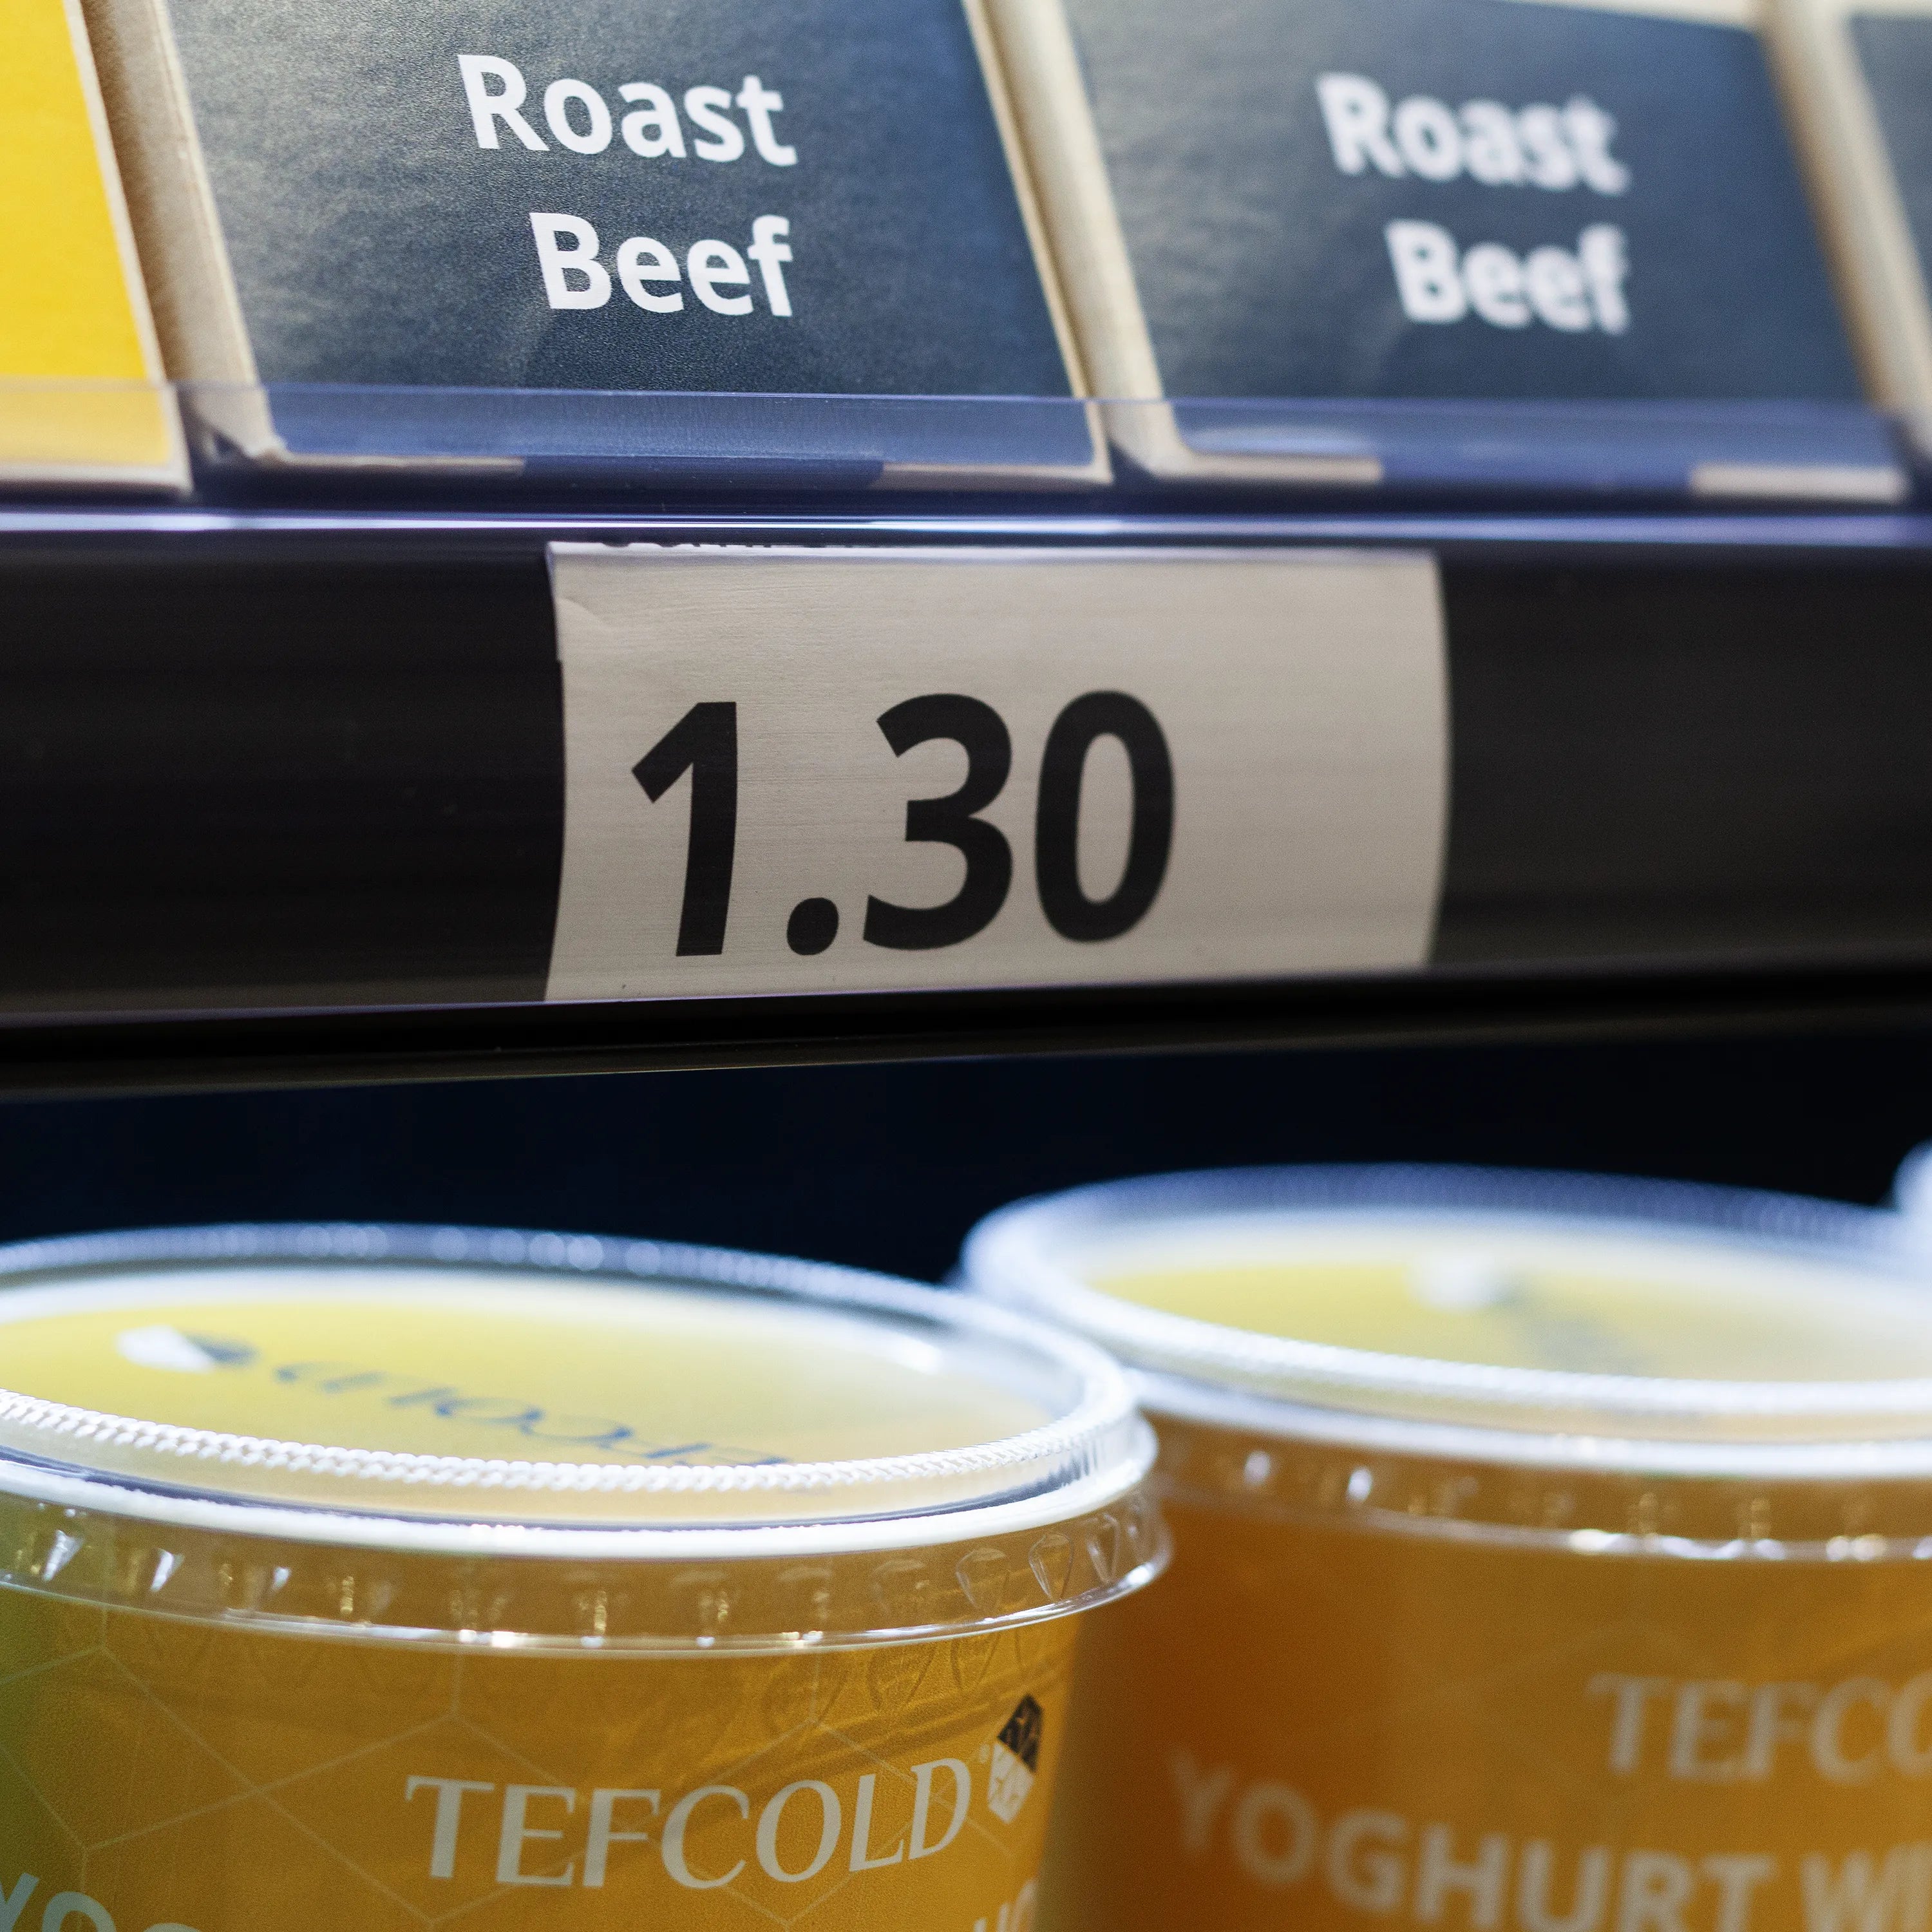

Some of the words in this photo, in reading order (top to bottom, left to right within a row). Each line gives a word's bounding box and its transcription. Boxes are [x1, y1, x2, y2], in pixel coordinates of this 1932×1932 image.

[458, 54, 797, 166] Roast
[1315, 72, 1632, 195] Roast
[529, 212, 793, 317] Beef
[1385, 219, 1629, 335] Beef
[631, 689, 1175, 956] 1.30
[405, 1757, 971, 1889] TEFCOLD
[1169, 1745, 1780, 1932] YOGHURT
